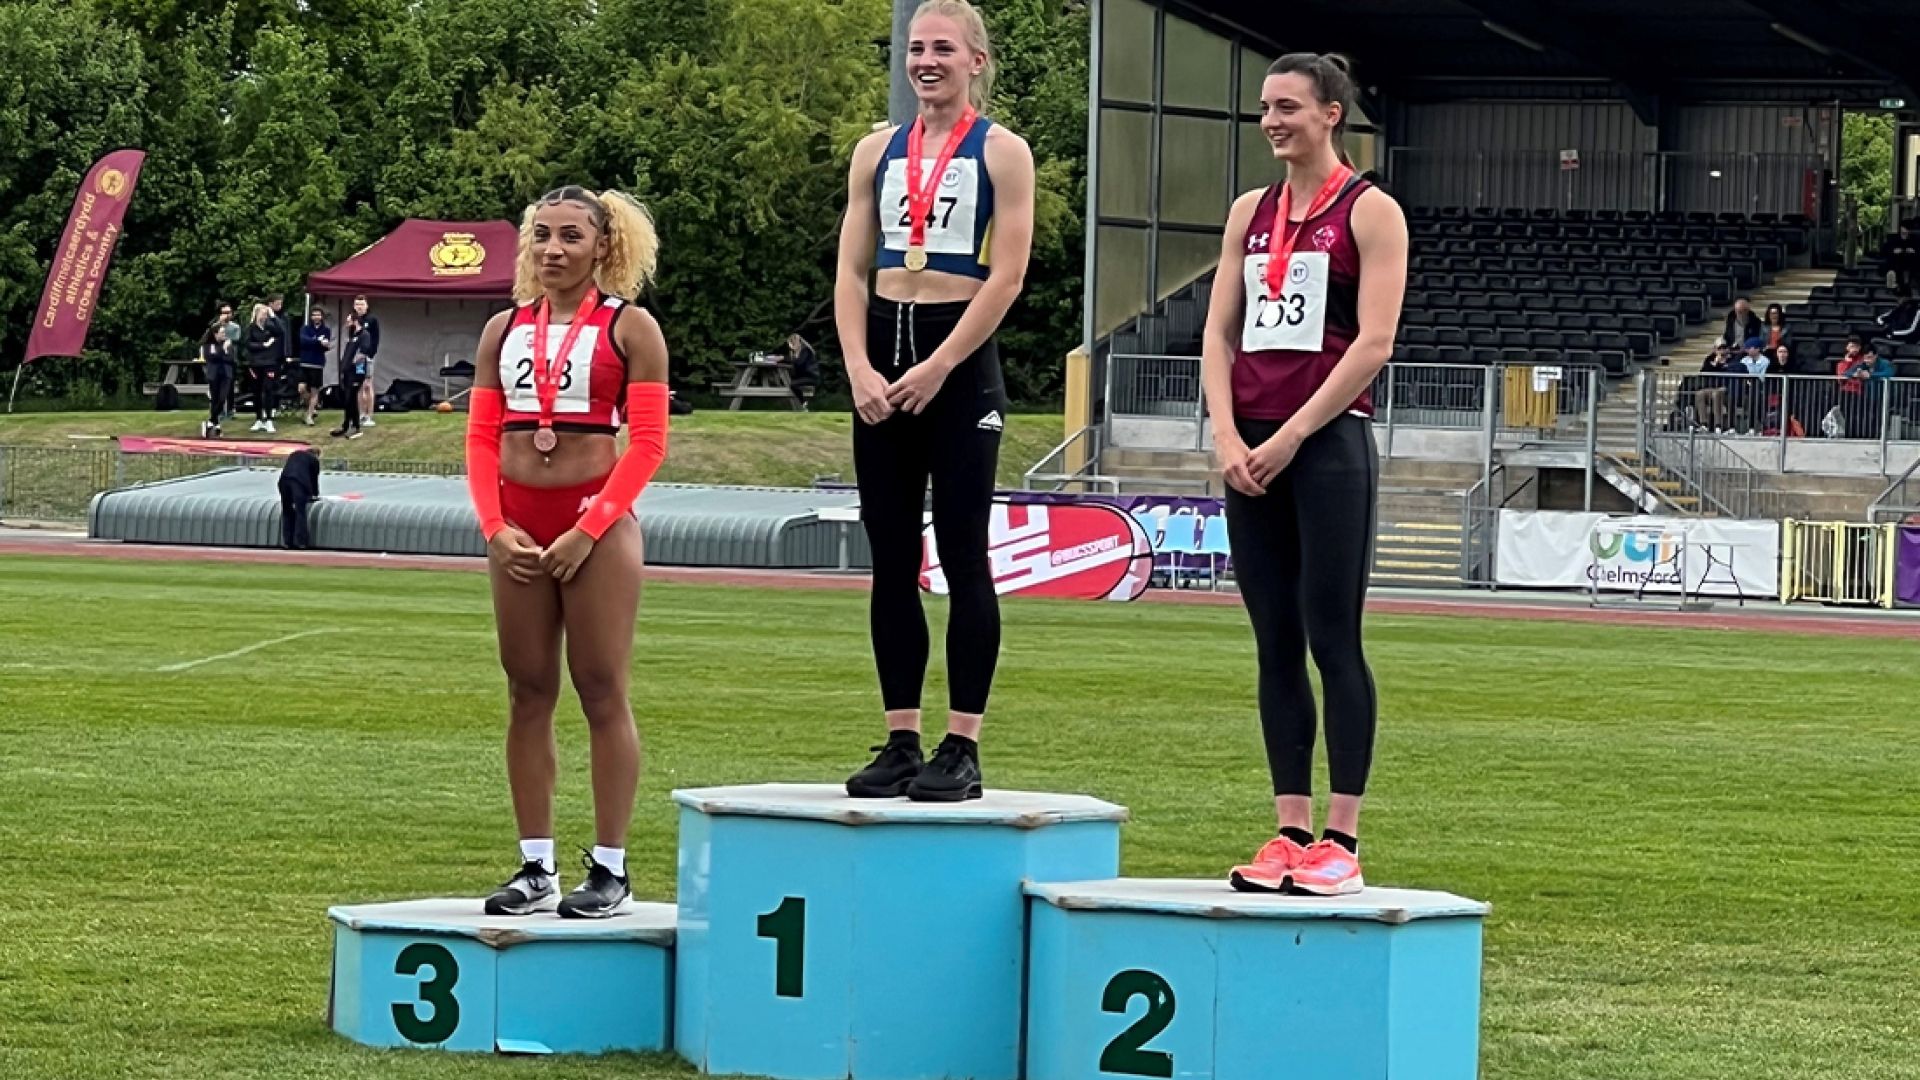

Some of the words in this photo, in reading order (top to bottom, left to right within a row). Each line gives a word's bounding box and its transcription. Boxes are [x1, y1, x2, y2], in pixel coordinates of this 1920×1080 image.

[76, 281, 96, 321] cross
[90, 222, 118, 278] country
[1586, 563, 1682, 584] Celmsord
[391, 942, 460, 1044] 3
[756, 896, 806, 998] 1
[1099, 969, 1176, 1079] 2
